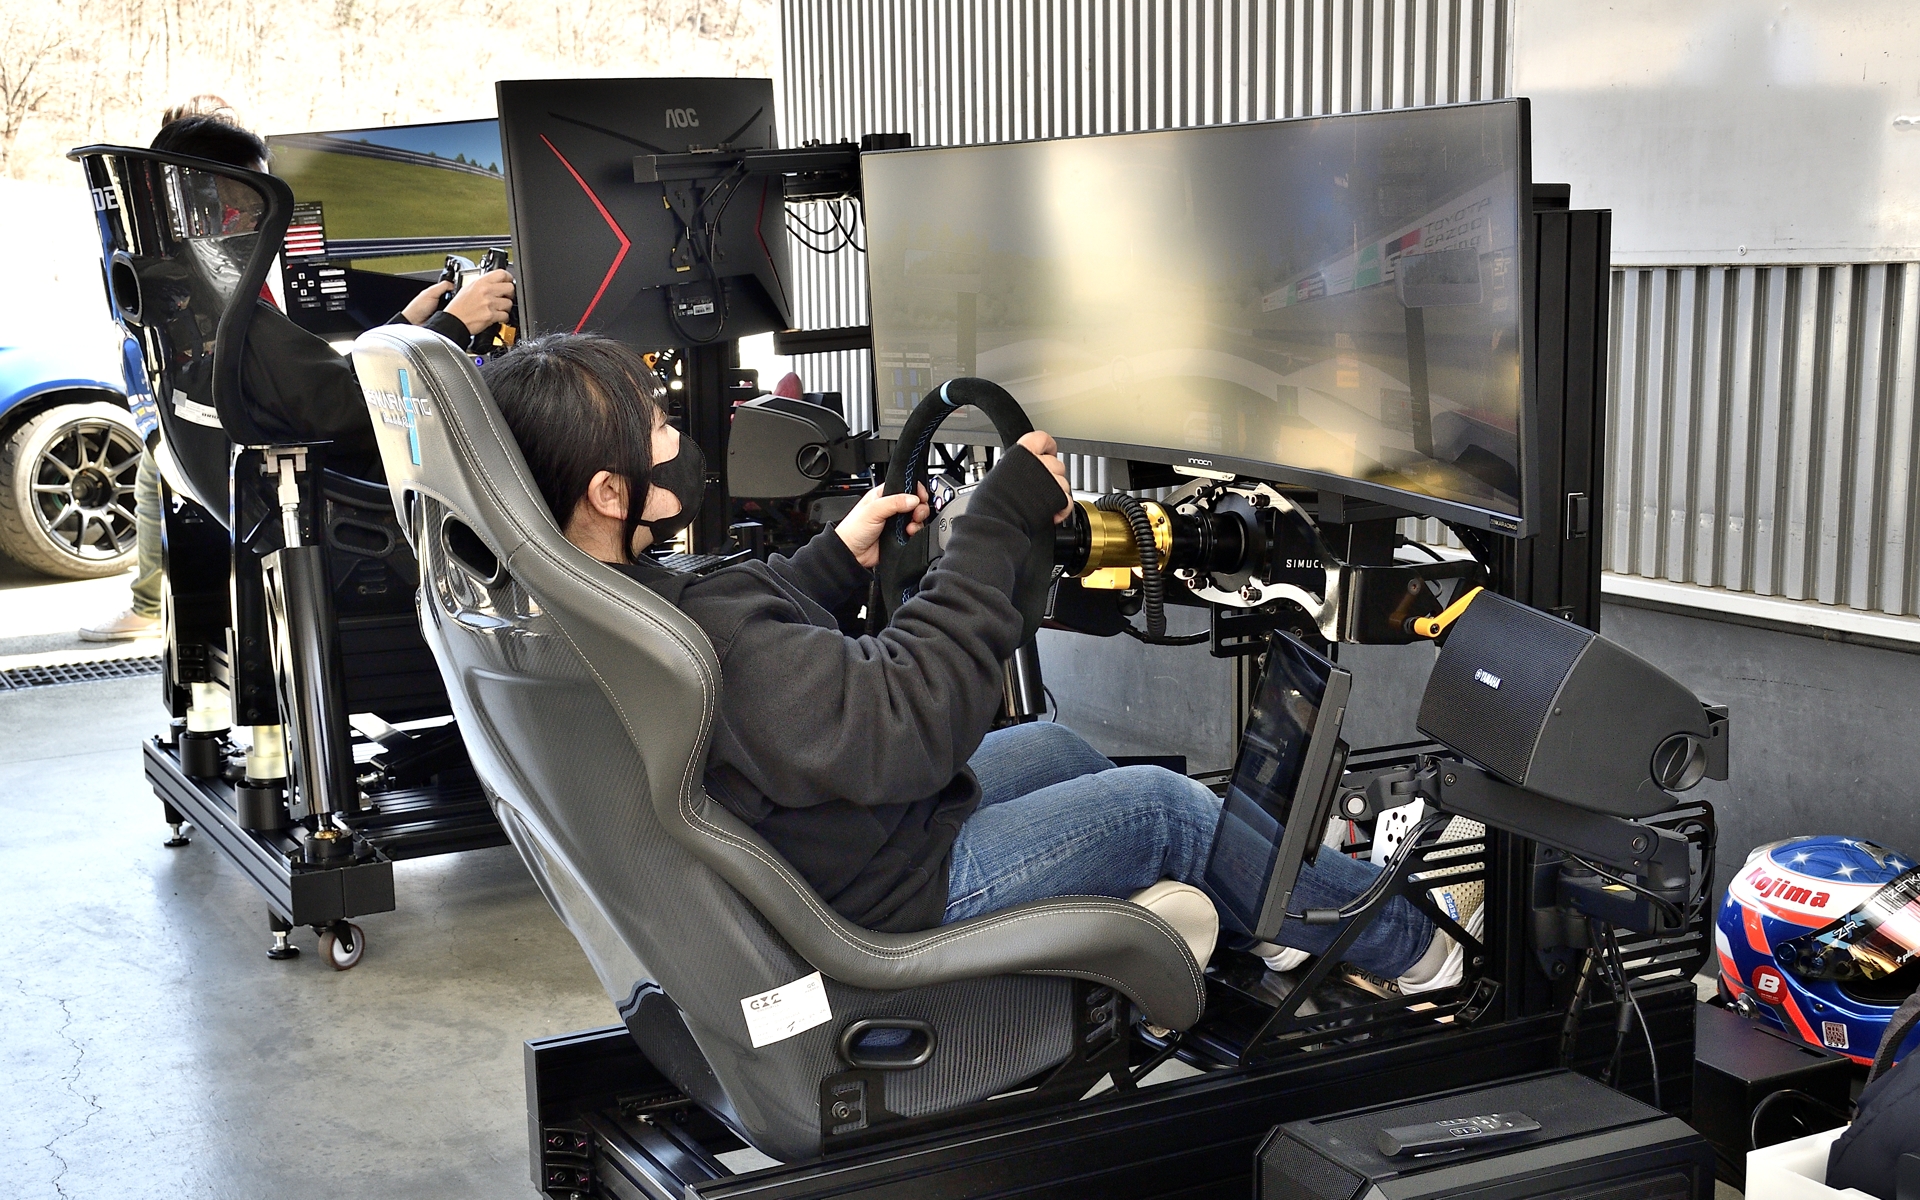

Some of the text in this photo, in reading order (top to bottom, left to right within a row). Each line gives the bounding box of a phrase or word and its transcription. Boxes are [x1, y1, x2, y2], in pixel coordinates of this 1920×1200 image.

[665, 107, 699, 128] AOC
[1423, 196, 1492, 234] TOYOTA
[1480, 670, 1501, 690] YAMAHA
[1745, 866, 1831, 908] Kojima
[1445, 894, 1458, 920] PEPSI
[1758, 972, 1780, 994] B
